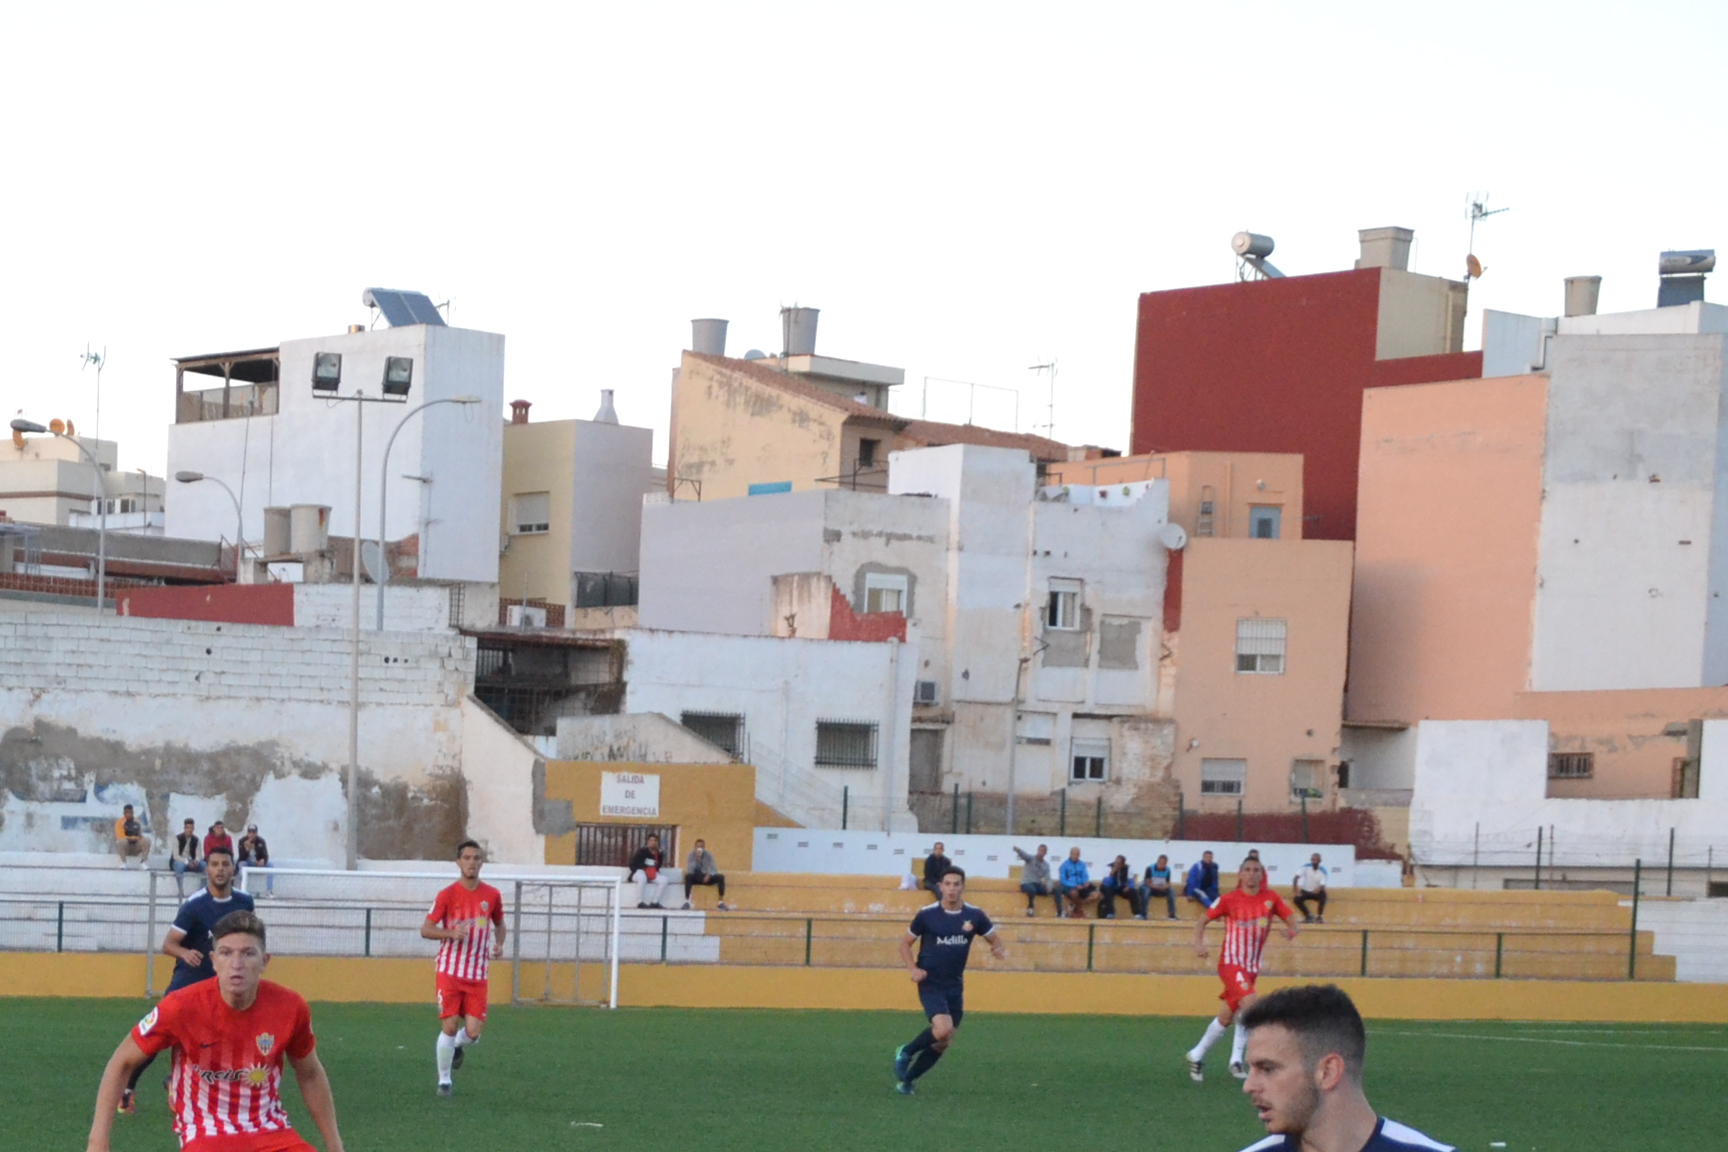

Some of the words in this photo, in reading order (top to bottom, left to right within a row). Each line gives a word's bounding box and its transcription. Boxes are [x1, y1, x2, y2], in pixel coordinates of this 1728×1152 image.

[616, 774, 644, 784] SALIDA
[625, 790, 636, 799] DE
[602, 805, 657, 815] EMERGENCIA
